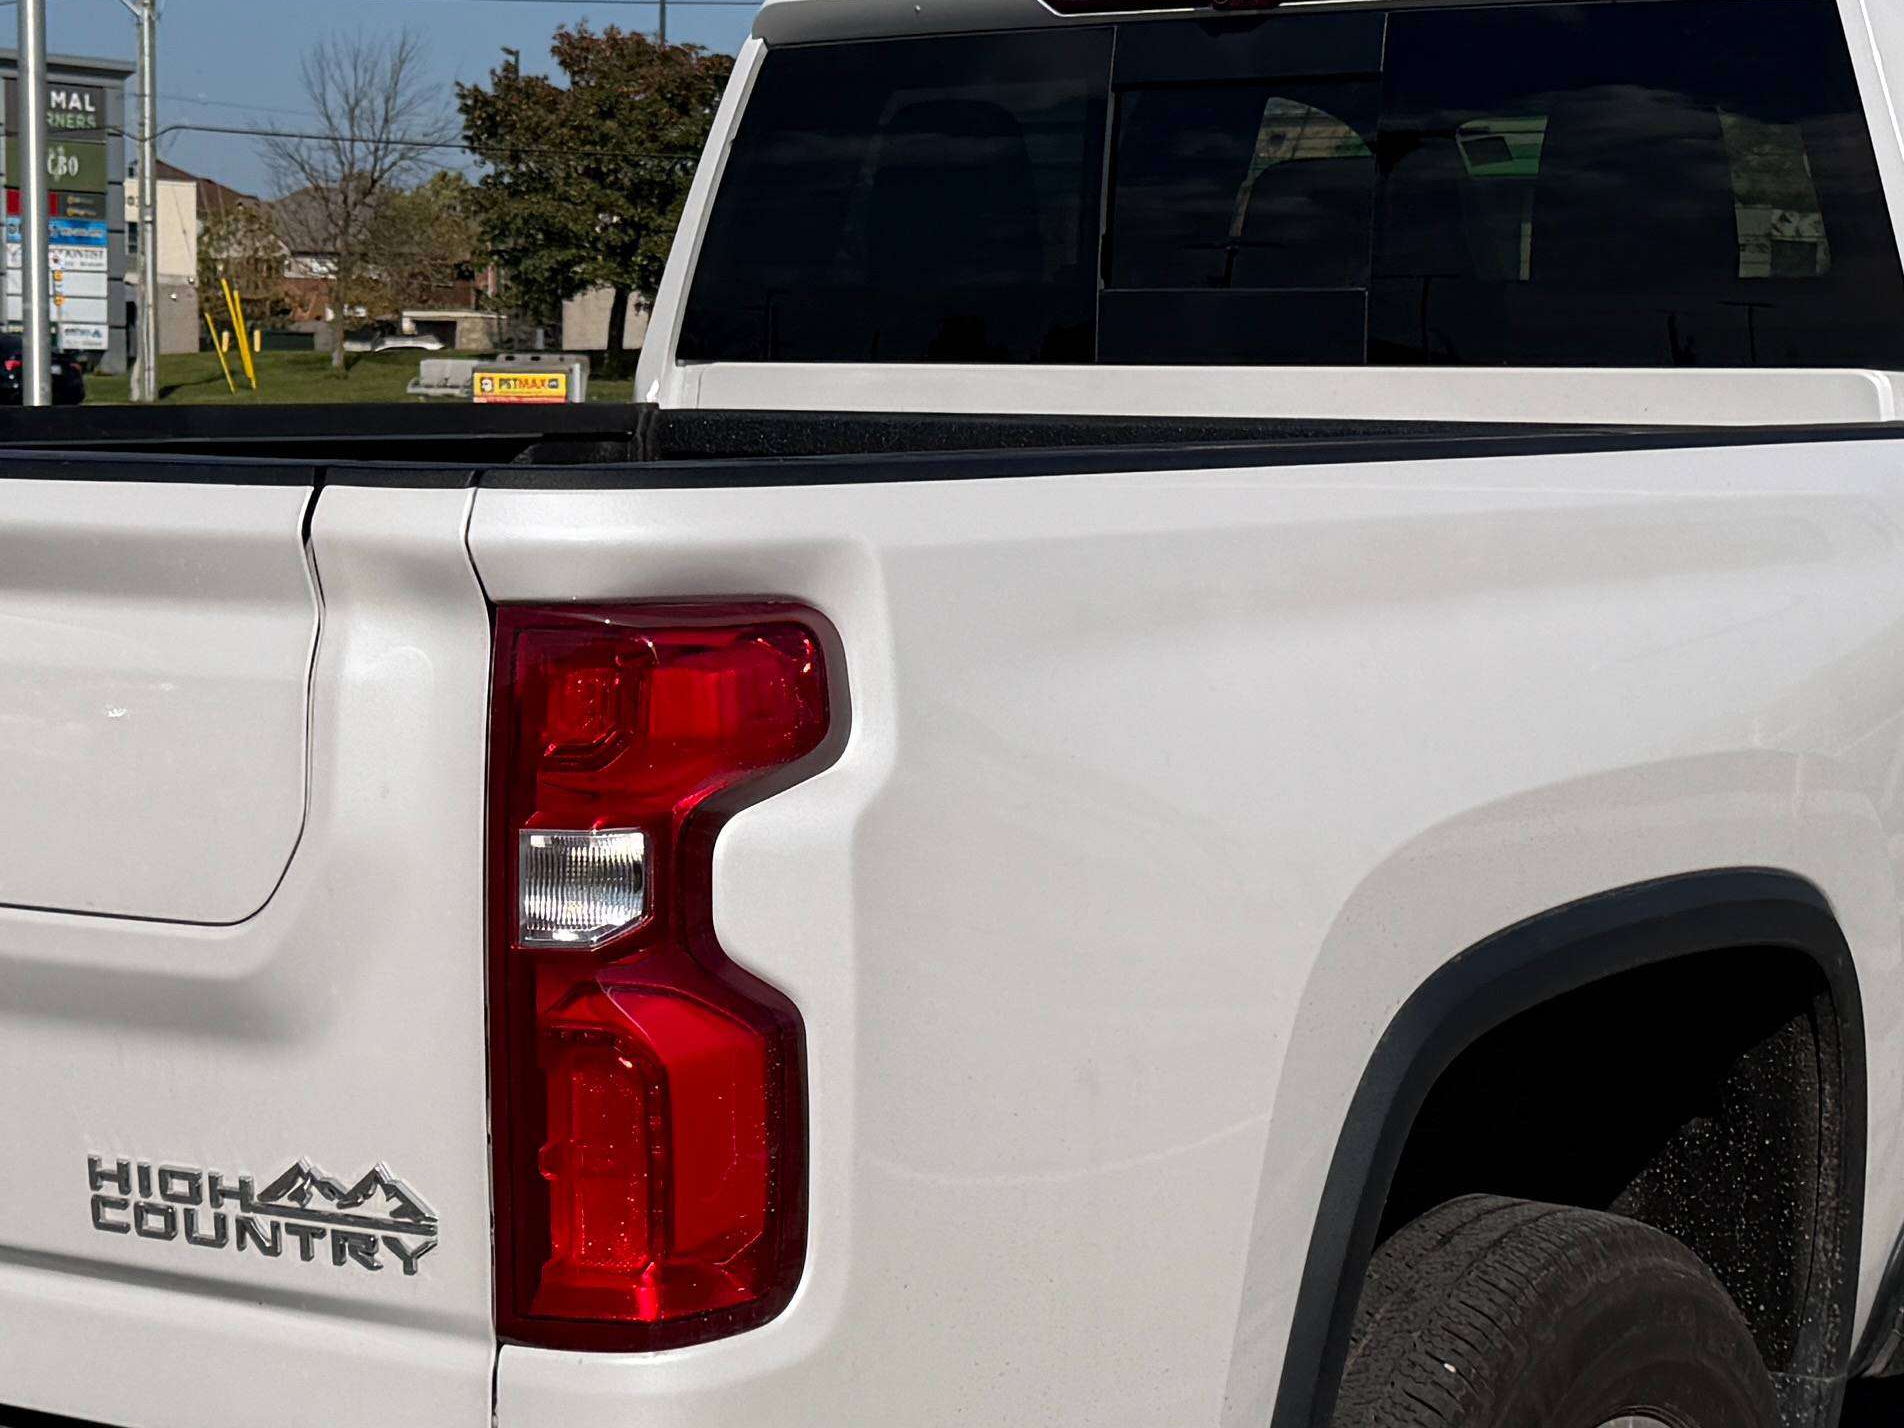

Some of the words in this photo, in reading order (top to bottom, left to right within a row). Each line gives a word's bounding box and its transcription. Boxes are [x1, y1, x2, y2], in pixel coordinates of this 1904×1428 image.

[47, 110, 96, 129] RNERS
[47, 155, 79, 176] CBO
[87, 1153, 256, 1214] HIGH
[90, 1192, 438, 1276] COUNTRY
